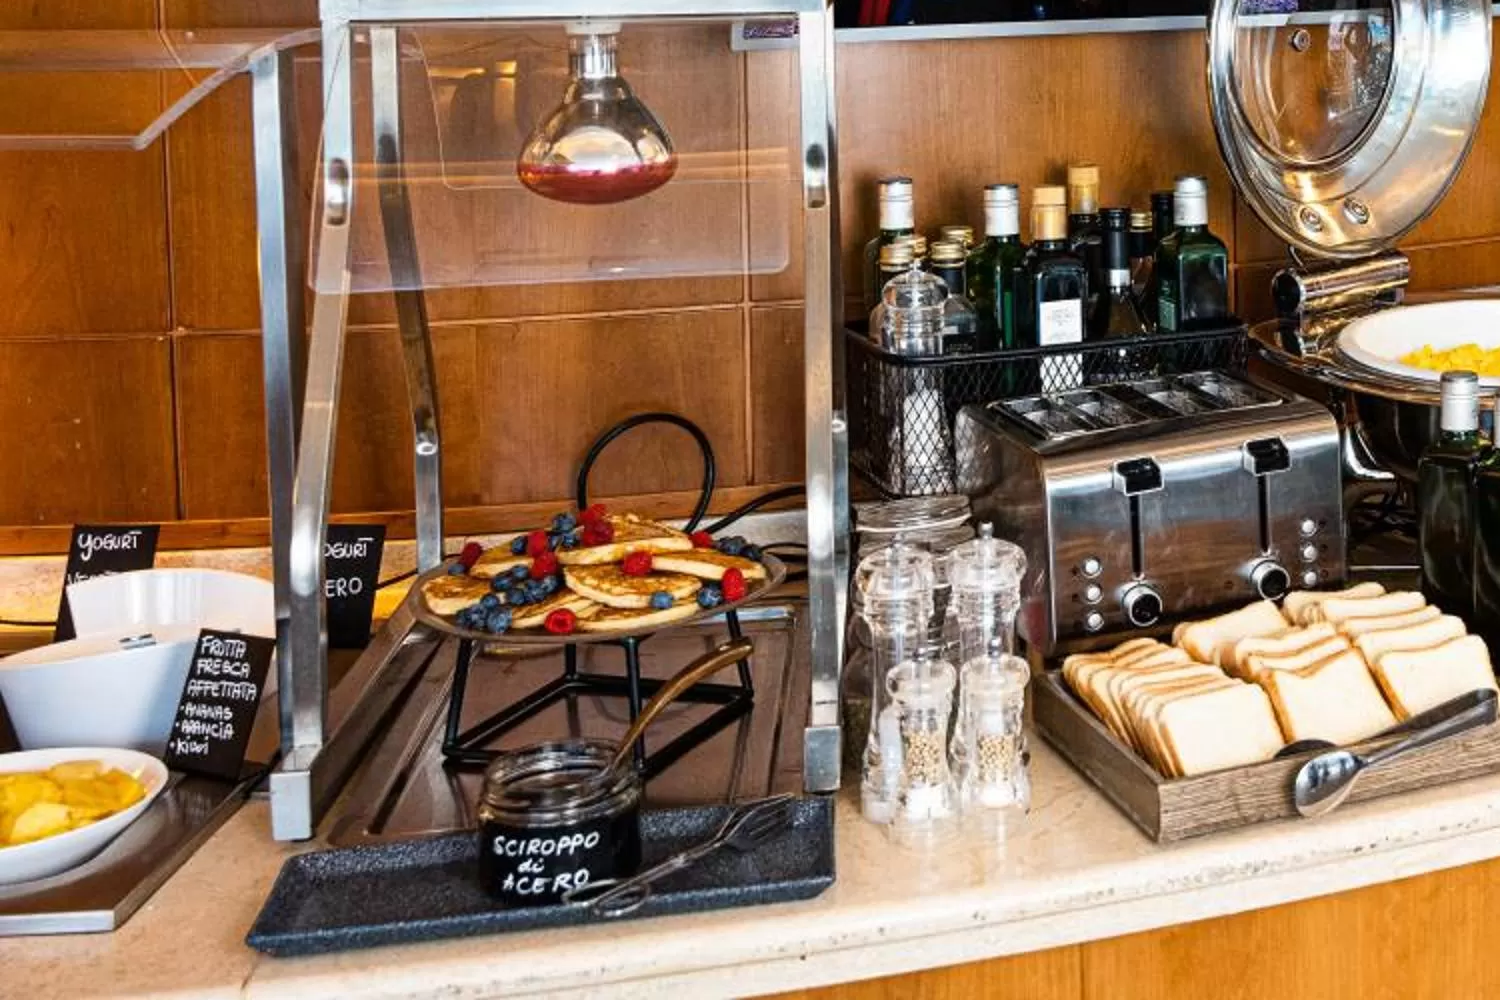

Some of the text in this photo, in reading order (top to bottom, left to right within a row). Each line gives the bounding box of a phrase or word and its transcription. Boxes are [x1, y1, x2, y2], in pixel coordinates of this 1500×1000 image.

[77, 530, 143, 561] YOGURT
[323, 537, 374, 559] OGURT
[324, 577, 363, 598] ERO
[196, 658, 251, 678] FRESCA
[187, 679, 257, 701] AFFETTATA
[493, 831, 600, 857] SCIROPPO
[502, 868, 590, 895] ACERO
